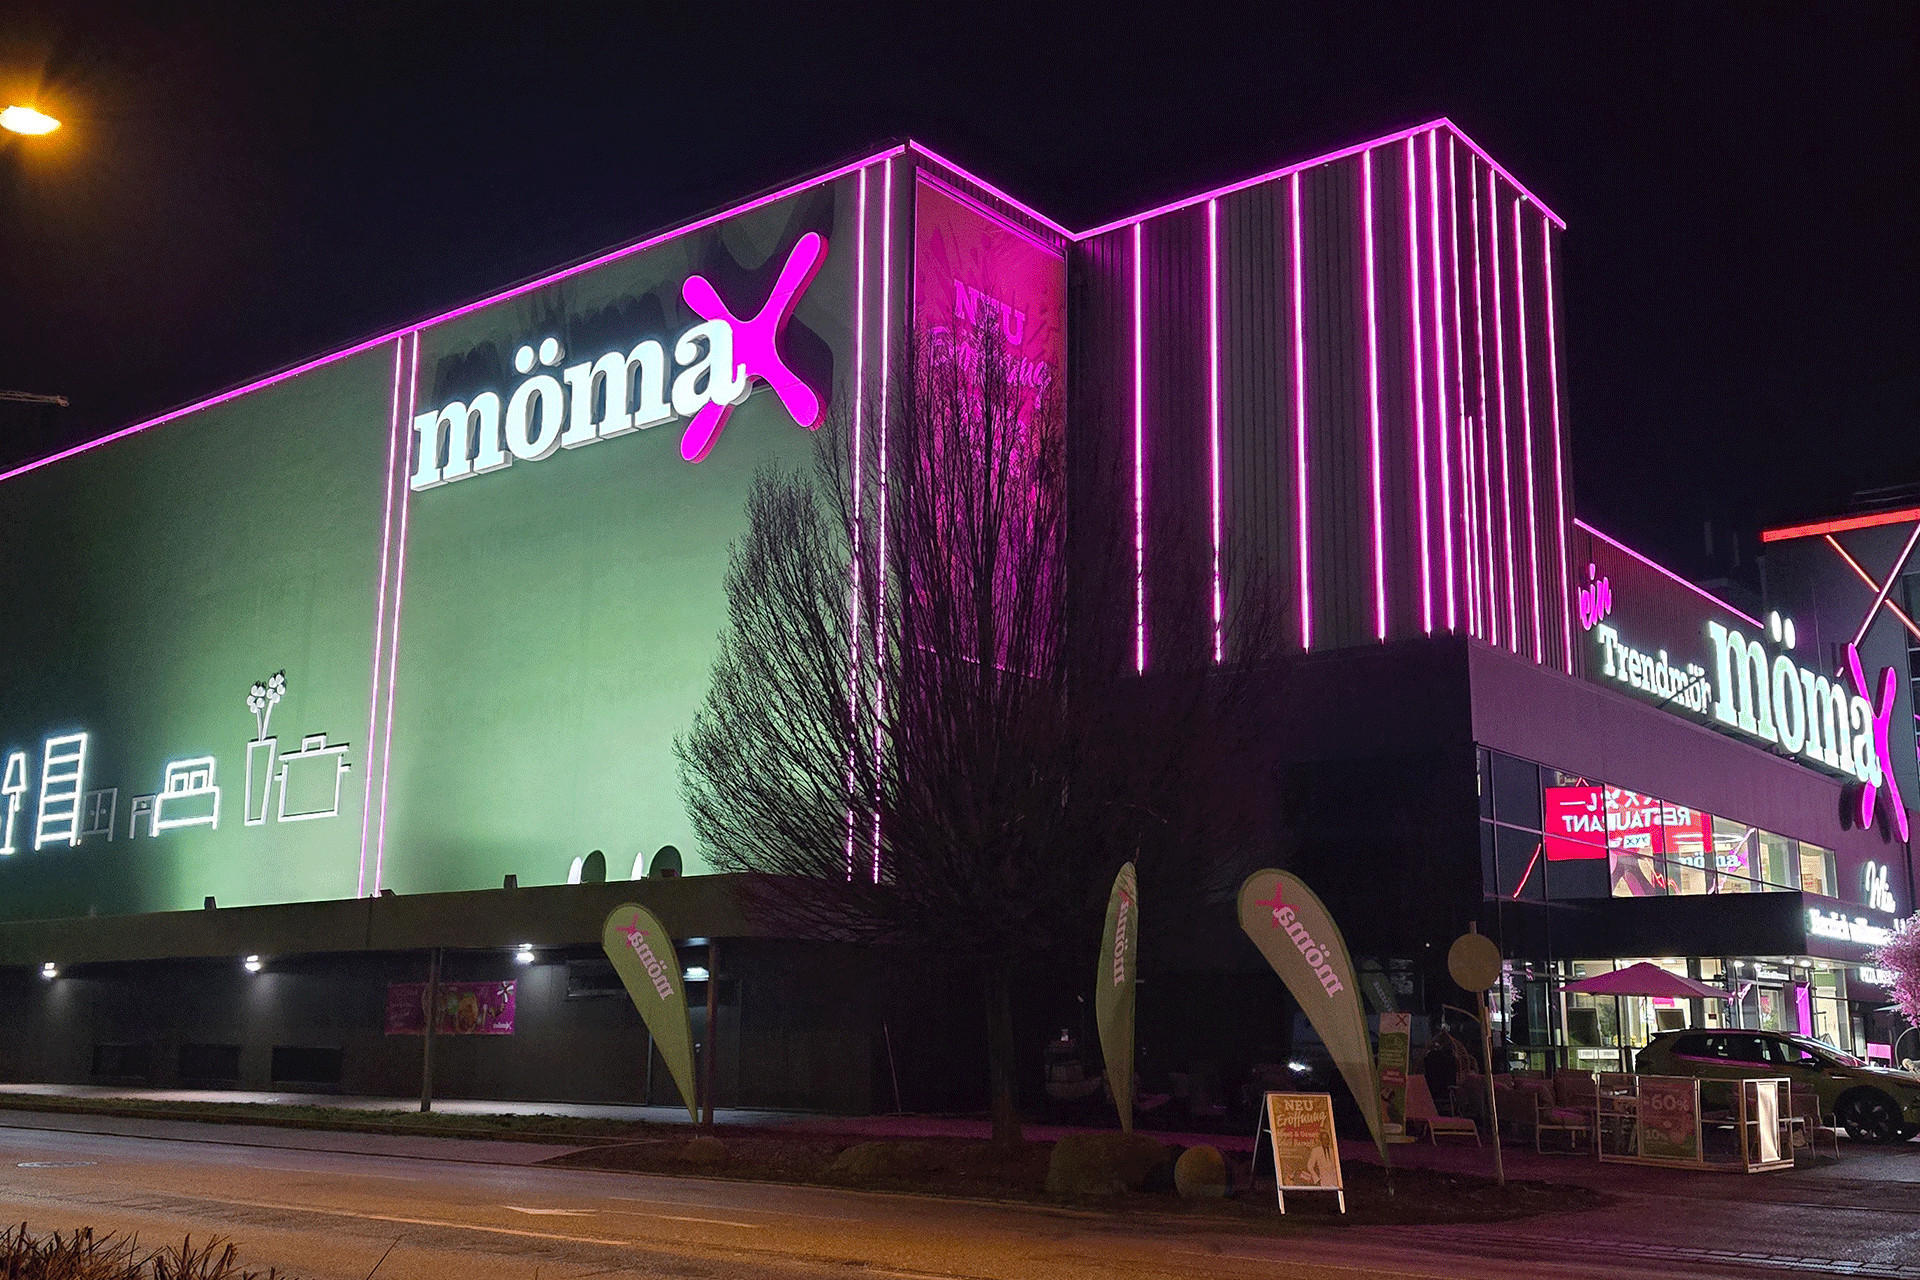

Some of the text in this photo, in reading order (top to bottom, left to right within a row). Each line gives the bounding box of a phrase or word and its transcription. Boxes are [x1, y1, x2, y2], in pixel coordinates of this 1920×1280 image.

[410, 232, 823, 491] mömax
[1579, 563, 1612, 631] ein
[1709, 611, 1909, 843] mömax
[1277, 1110, 1328, 1128] Eröffnung
[1284, 1099, 1314, 1111] NEU
